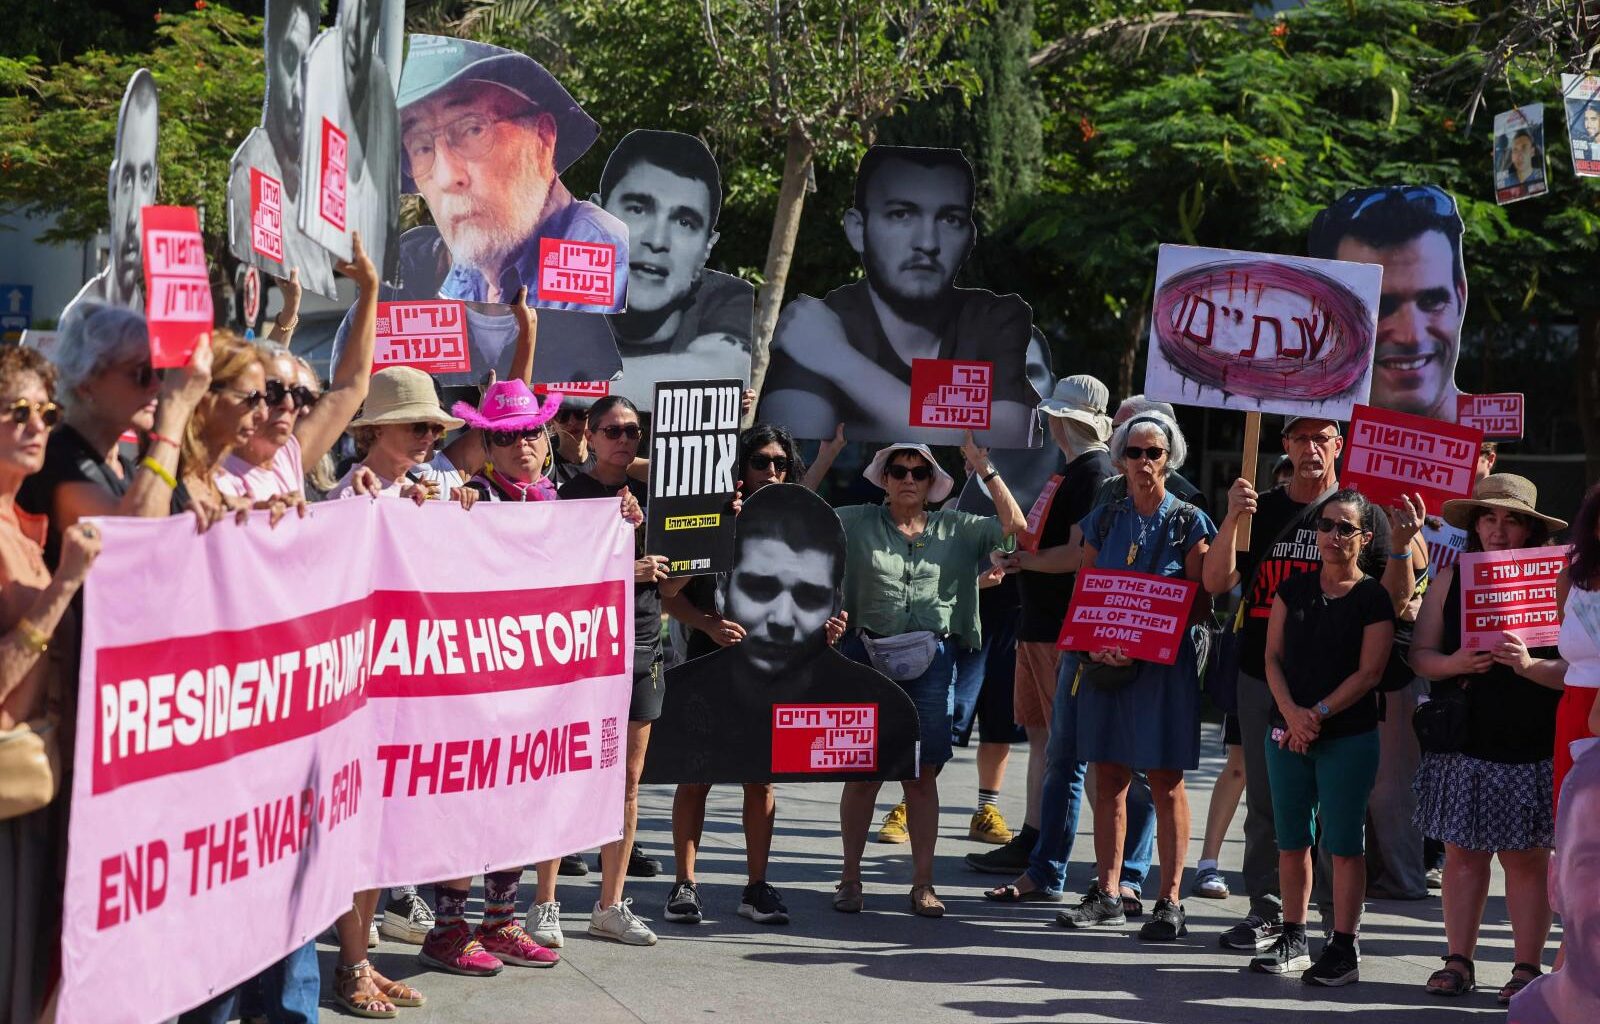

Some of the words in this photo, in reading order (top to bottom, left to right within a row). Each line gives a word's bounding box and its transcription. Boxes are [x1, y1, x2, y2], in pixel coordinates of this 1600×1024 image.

[563, 246, 610, 268] עדיין
[550, 271, 609, 293] בעזה.
[395, 306, 458, 332] עדיין
[383, 337, 462, 360] בעזה.
[958, 369, 986, 384] בר
[942, 387, 986, 403] עדיין
[656, 386, 740, 433] שכחתם
[1476, 398, 1518, 414] עדיין
[929, 407, 985, 423] בעזה.
[1360, 422, 1436, 454] החטוף
[1440, 438, 1471, 460] עד
[655, 433, 737, 498] אותנו
[1366, 453, 1453, 486] האחרון
[1272, 542, 1305, 559] הביתה
[1493, 565, 1520, 579] עזה
[1524, 561, 1563, 577] כיבוש
[1085, 578, 1113, 589] END
[1117, 580, 1145, 592] THE
[1149, 584, 1183, 598] WAR
[1104, 594, 1151, 610] BRING
[1474, 590, 1527, 605] החטופים
[1077, 610, 1103, 620] ALL
[1107, 611, 1126, 622] OF
[1130, 614, 1171, 630] THEM
[1476, 614, 1523, 628] החיילים
[1093, 626, 1143, 643] HOME
[102, 650, 300, 765] PRESIDENT
[369, 619, 465, 680] AKE
[779, 710, 820, 725] חיים
[827, 710, 867, 727] יוסף
[829, 730, 871, 746] עדיין
[818, 751, 871, 765] בעזה.
[97, 839, 169, 932] END
[183, 812, 249, 897] THE
[254, 788, 315, 868] WAR
[329, 758, 362, 832] BRIN
[377, 737, 501, 798] THEM
[507, 720, 592, 786] HOME
